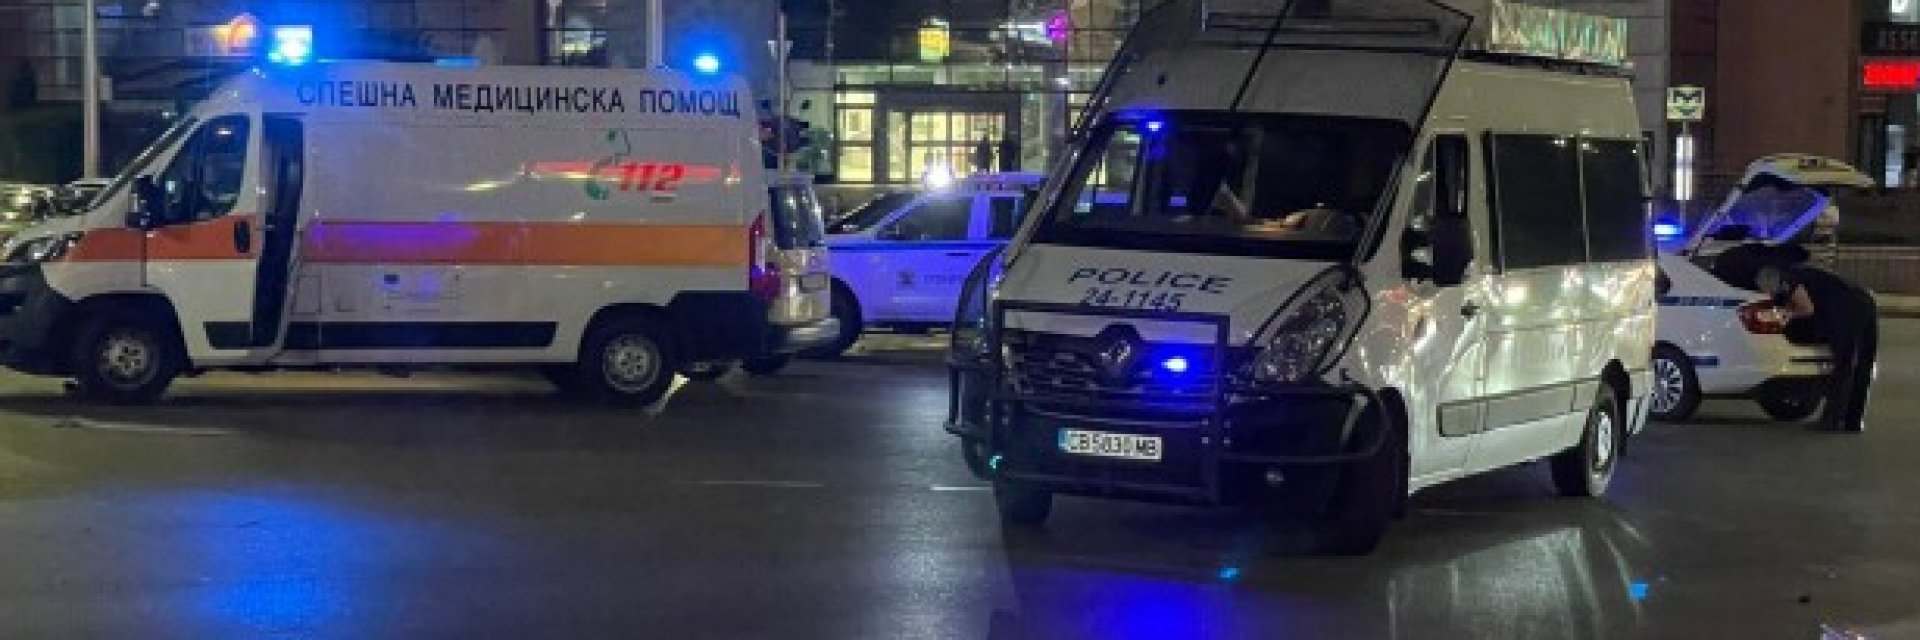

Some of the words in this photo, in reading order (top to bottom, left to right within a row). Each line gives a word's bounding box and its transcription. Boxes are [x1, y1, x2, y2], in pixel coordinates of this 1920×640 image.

[296, 79, 416, 108] СПЕШНА
[433, 83, 625, 115] МЕДИЦИНСКА
[639, 89, 740, 119] ПОМОЩ
[617, 163, 684, 191] 112
[1067, 267, 1234, 295] POLICE
[1080, 287, 1187, 312] 24-1145
